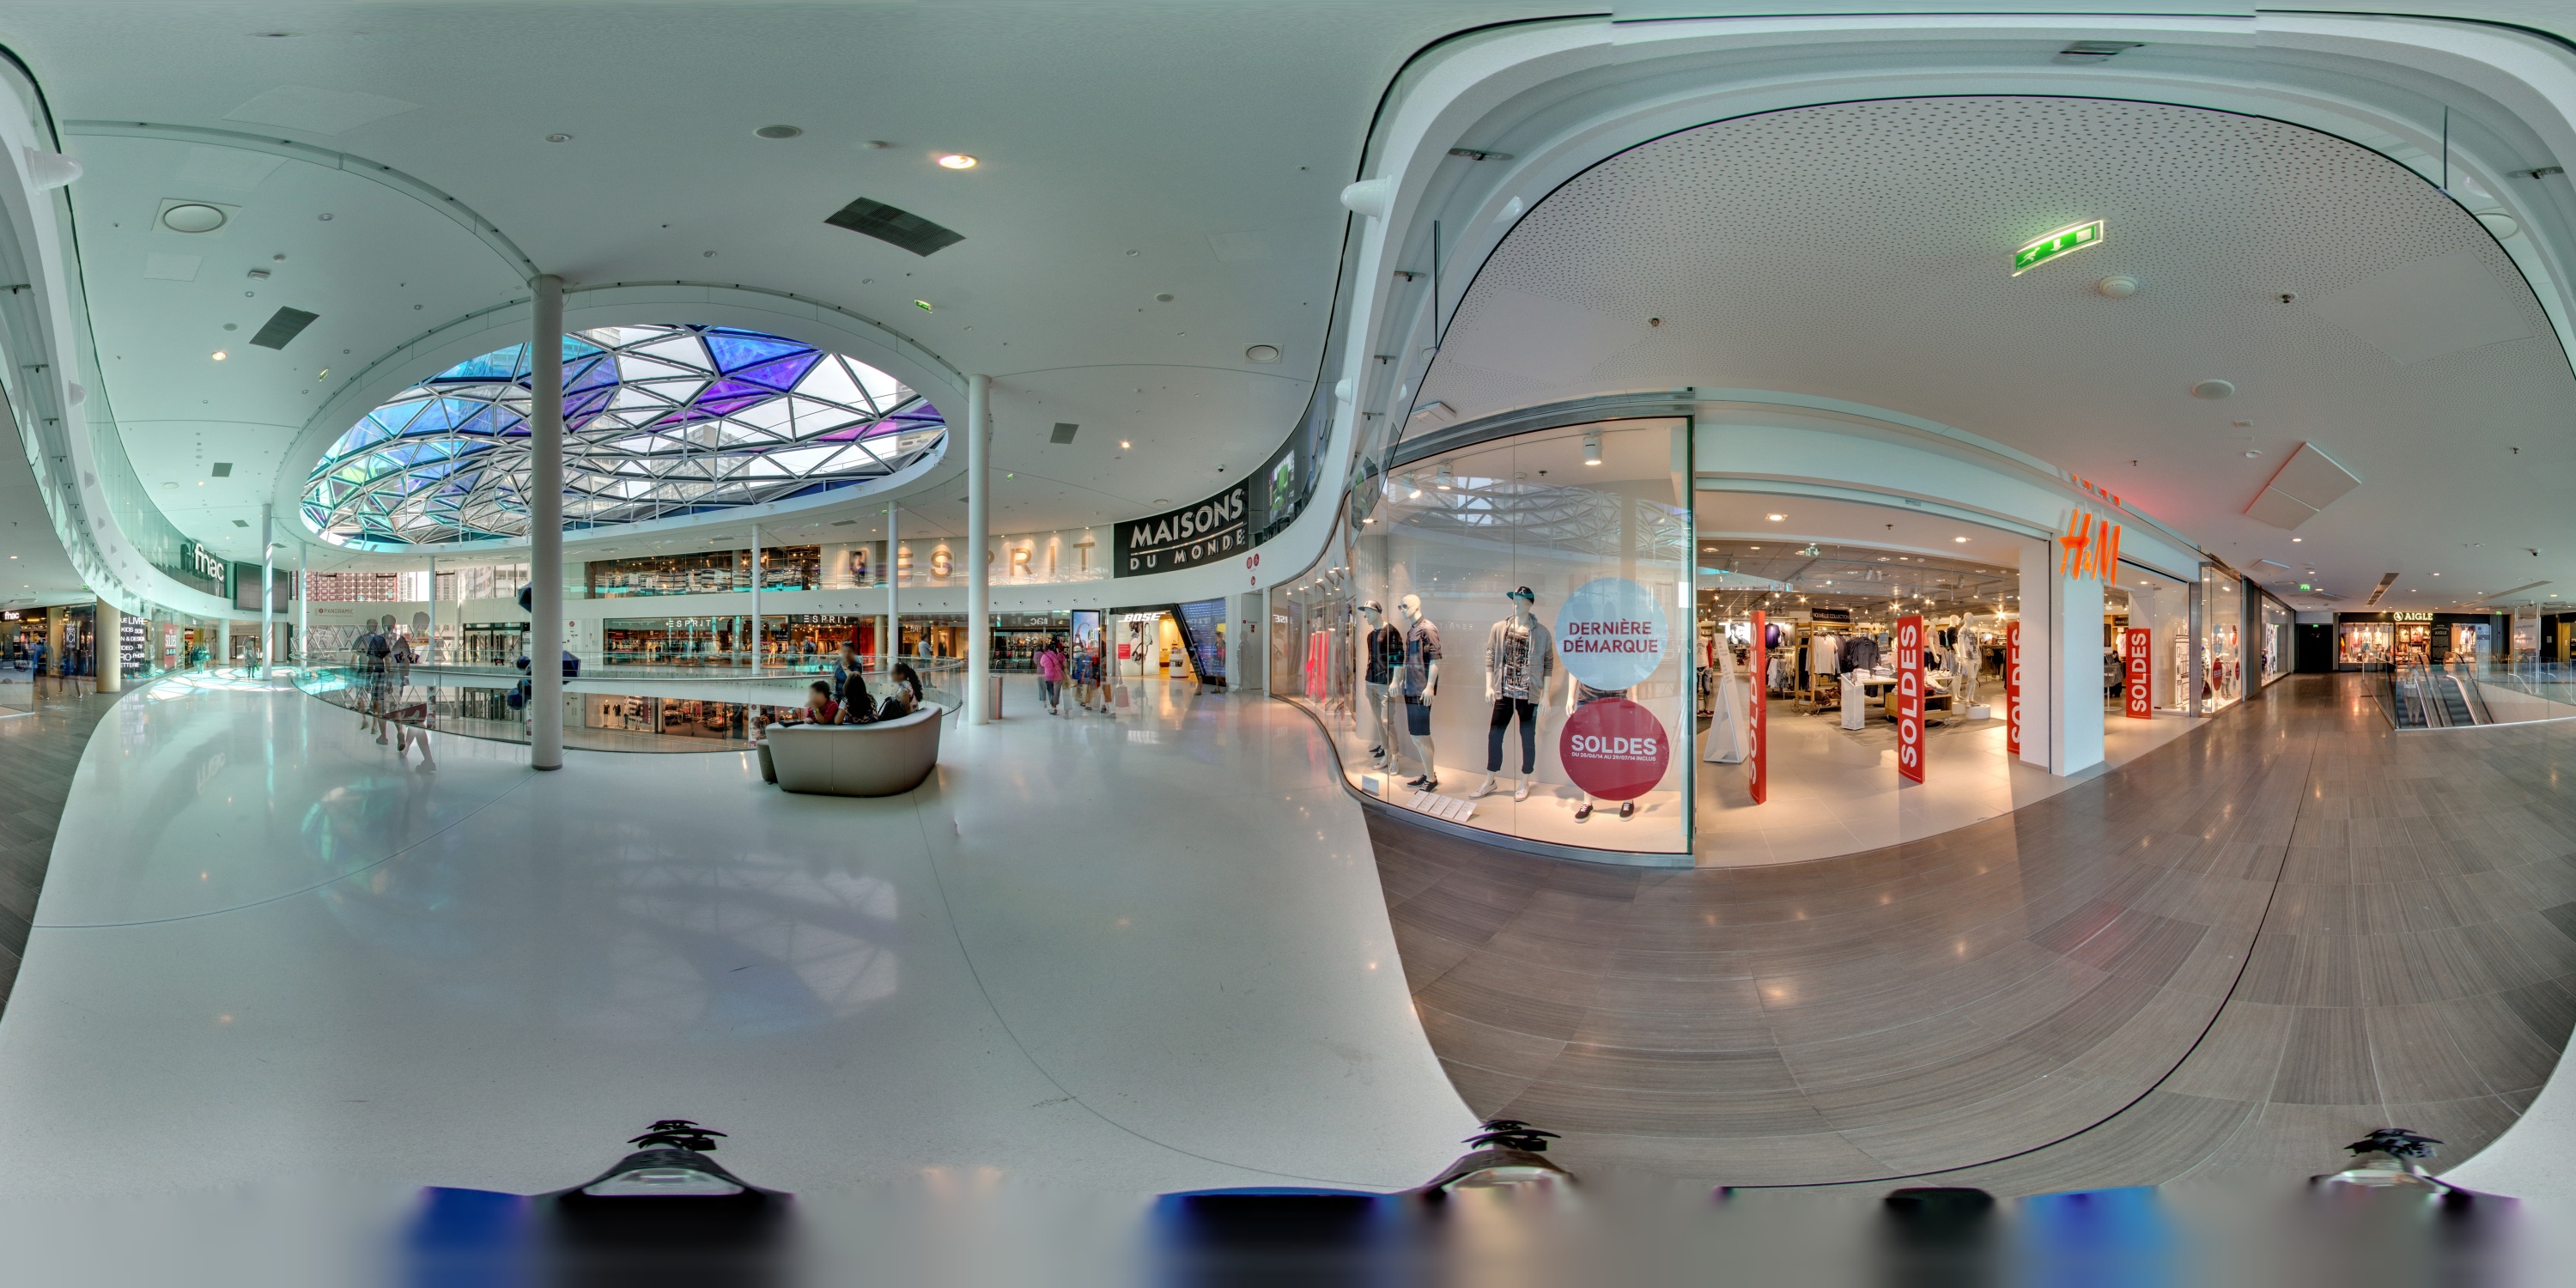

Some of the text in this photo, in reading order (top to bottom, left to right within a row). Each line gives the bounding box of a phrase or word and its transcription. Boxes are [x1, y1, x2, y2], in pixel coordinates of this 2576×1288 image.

[1130, 488, 1245, 549] MAISONS
[1130, 528, 1245, 570] DU MONDE
[2059, 508, 2122, 587] H&M
[194, 542, 224, 581] fnac
[897, 542, 1096, 579] ESRIT
[4, 611, 20, 620] fnac
[668, 619, 712, 628] ESPRIT
[804, 615, 848, 623] ESPRIT
[1118, 612, 1166, 623] BOSE
[2404, 612, 2433, 621] AIGLE
[1569, 618, 1652, 635] DERNIÈRE
[165, 634, 177, 647] SOLDES
[1563, 636, 1658, 653] DÉMARQUE
[2132, 633, 2147, 713] SOLDES
[1901, 624, 1917, 768] SOLDES
[1571, 734, 1657, 756] SOLDES
